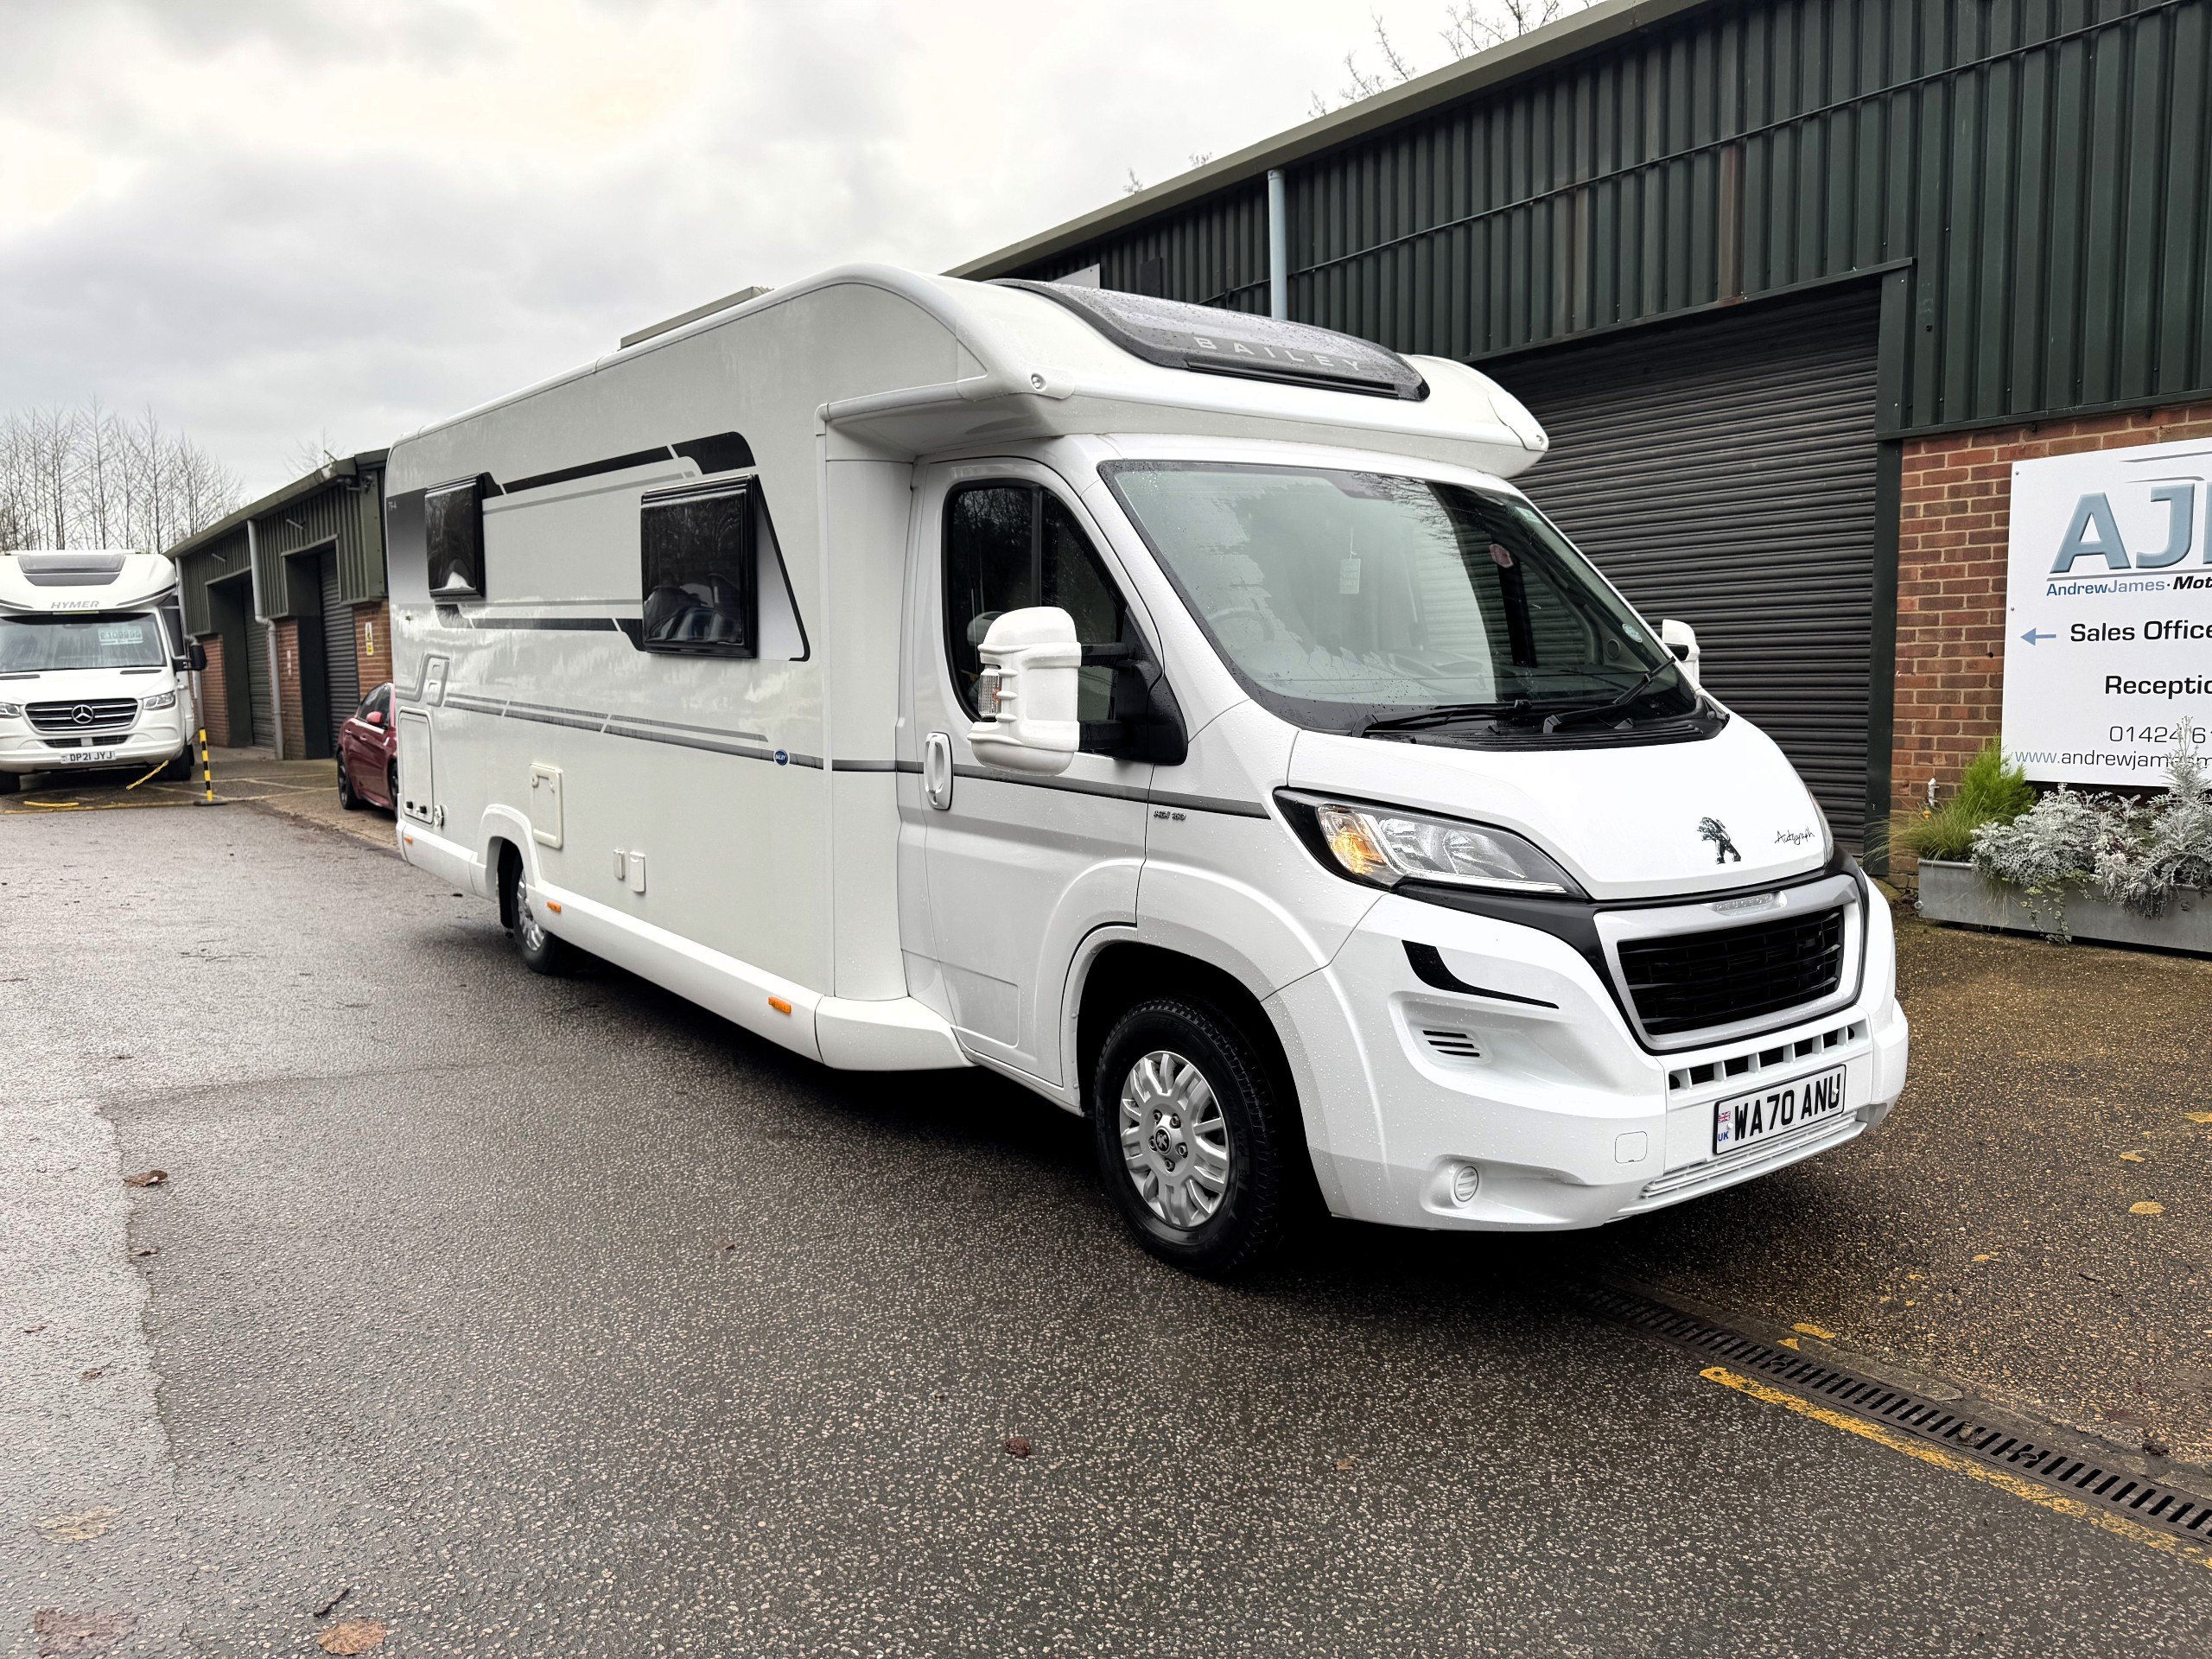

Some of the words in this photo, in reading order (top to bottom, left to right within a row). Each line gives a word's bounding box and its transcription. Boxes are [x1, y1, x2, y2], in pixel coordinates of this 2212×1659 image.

[1193, 336, 1359, 372] BAILEY
[2050, 482, 2212, 574] AJ
[51, 601, 99, 609] HYMER
[2070, 622, 2136, 642] Sales
[70, 753, 92, 761] DP21
[94, 751, 112, 760] JYJ
[1774, 826, 1815, 846] Autograph
[1734, 1089, 1795, 1141] WA70
[1800, 1073, 1841, 1120] ANU
[1718, 1131, 1729, 1142] UK
